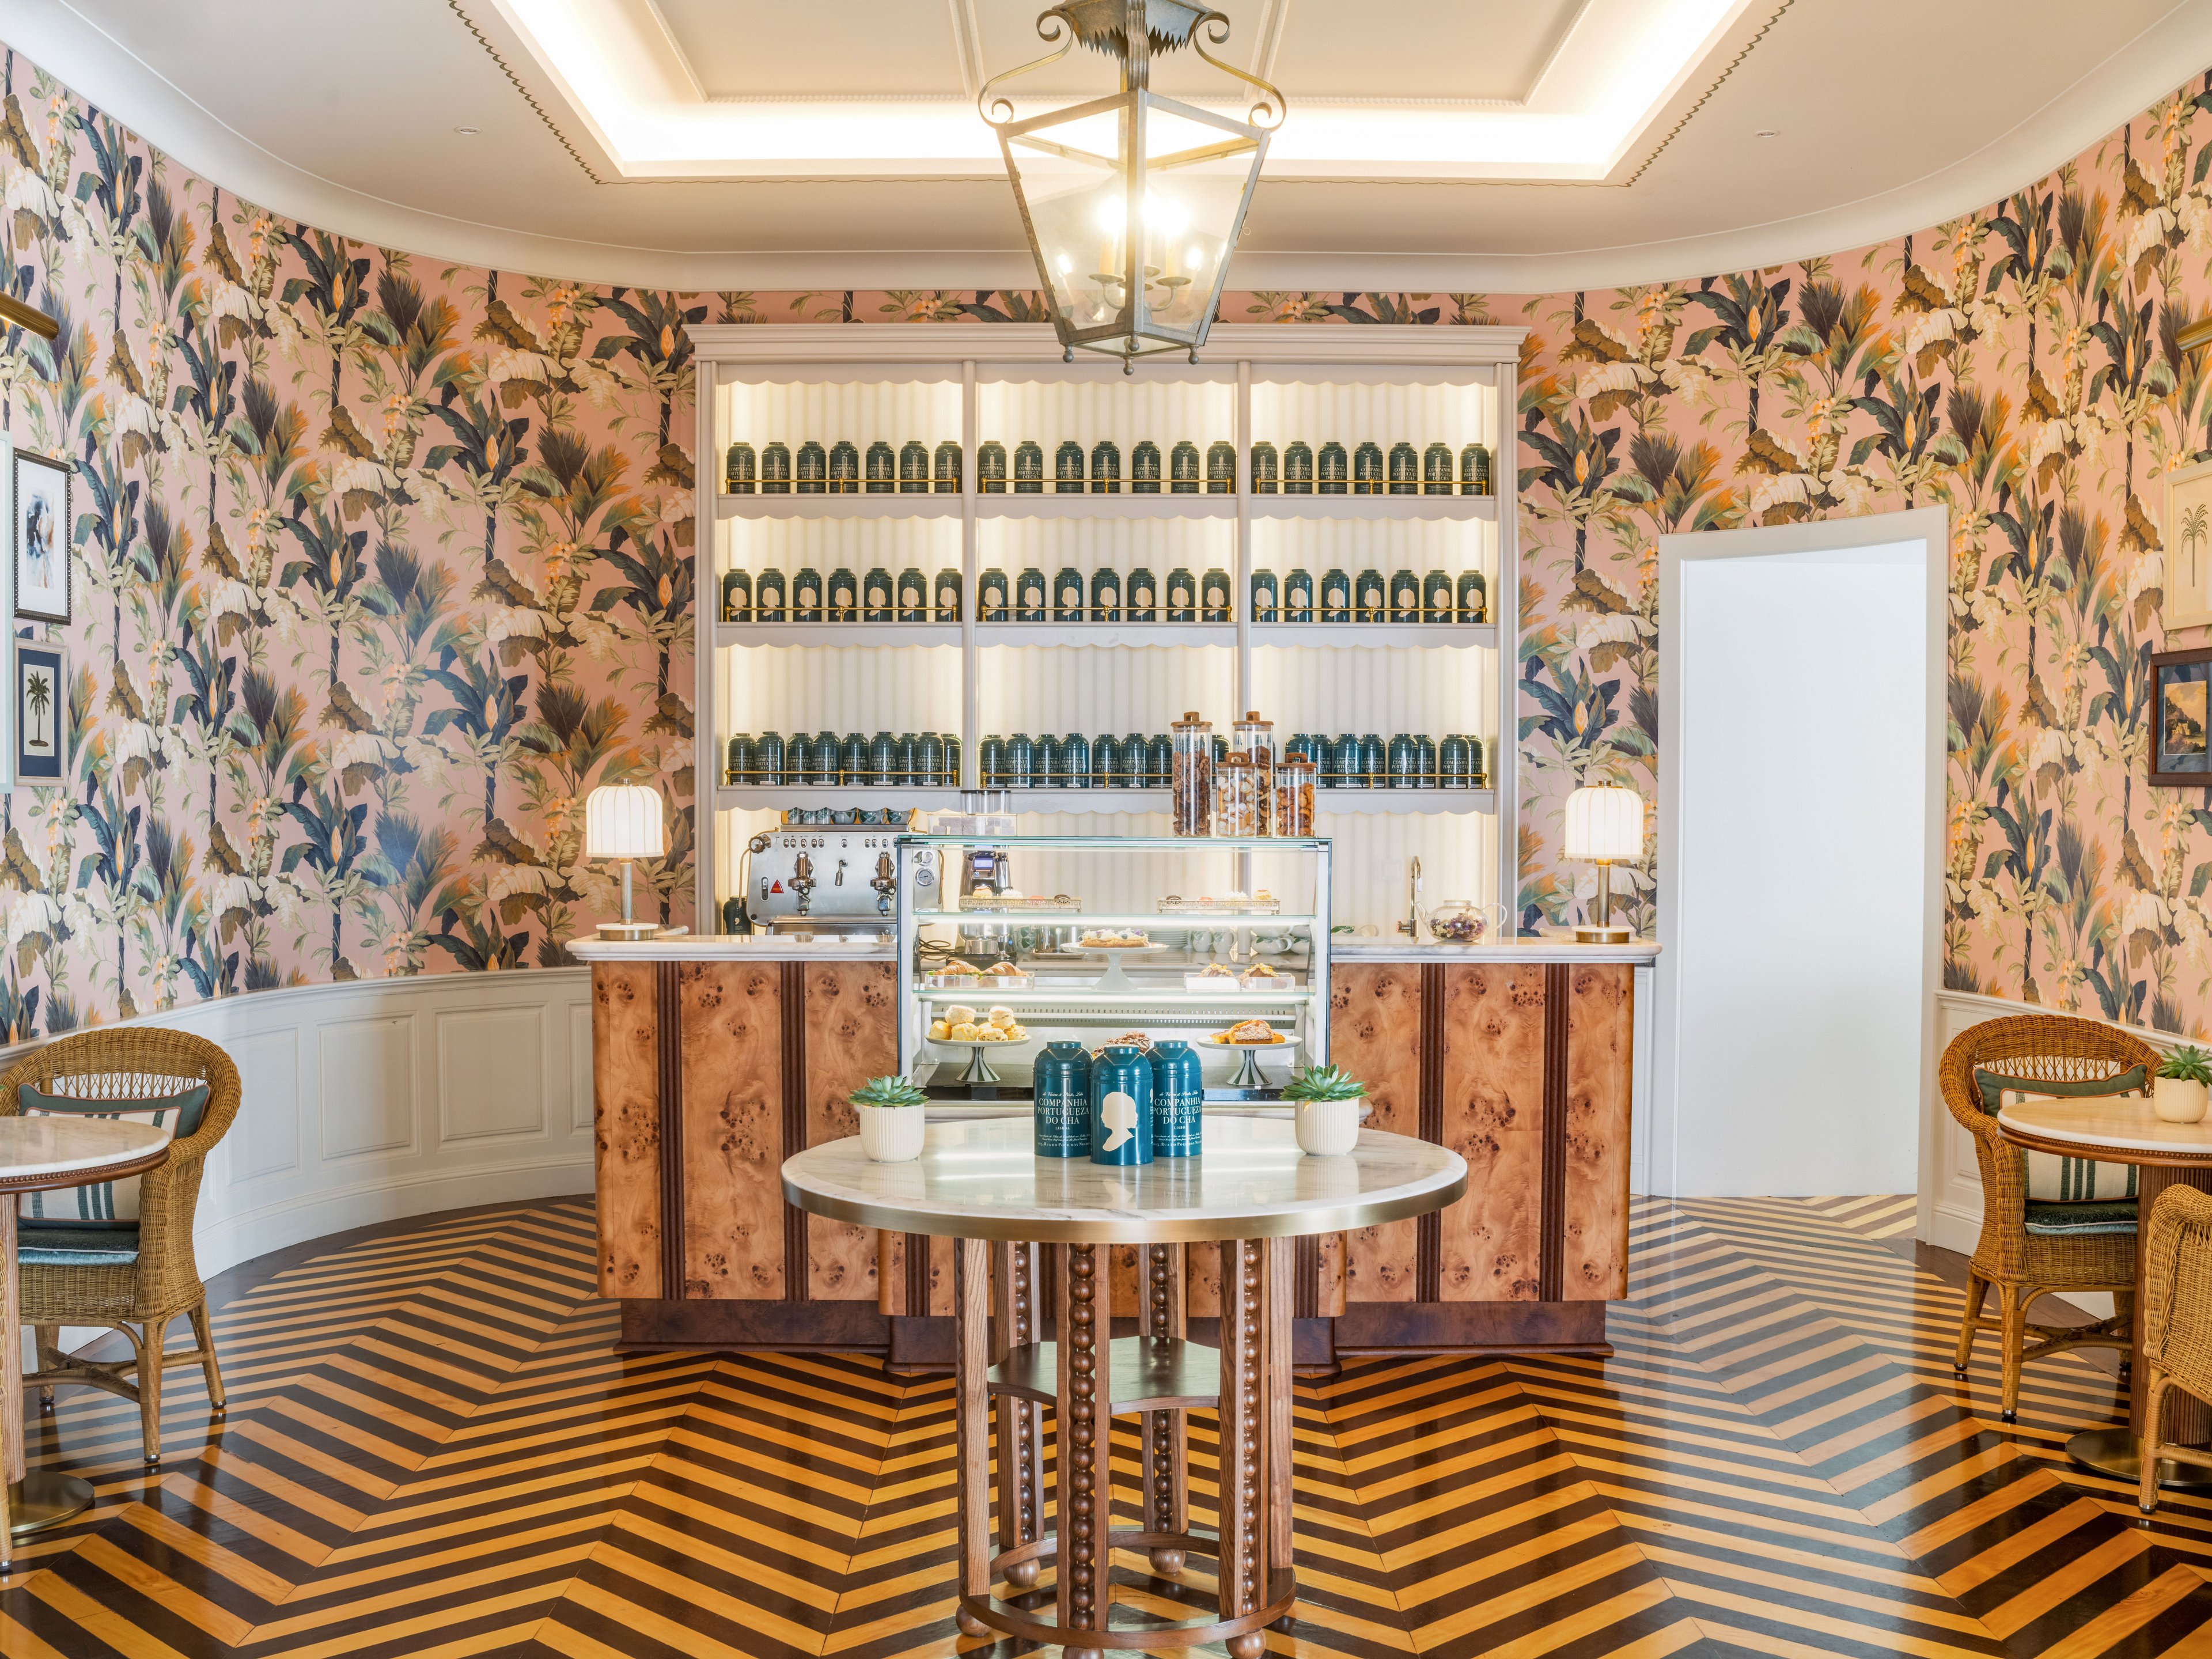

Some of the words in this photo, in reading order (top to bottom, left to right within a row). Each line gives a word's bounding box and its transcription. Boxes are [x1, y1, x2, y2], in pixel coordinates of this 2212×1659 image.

[1039, 1098, 1087, 1107] COMPANHIA
[1154, 1097, 1200, 1106] COMPANHIA
[1037, 1106, 1089, 1115] PORTUGUEZA
[1153, 1105, 1202, 1115] PORTUGUEZA
[1046, 1116, 1058, 1124] DO
[1060, 1115, 1080, 1124] CHÁ
[1163, 1116, 1177, 1124] DO
[1179, 1113, 1196, 1124] CHÁ
